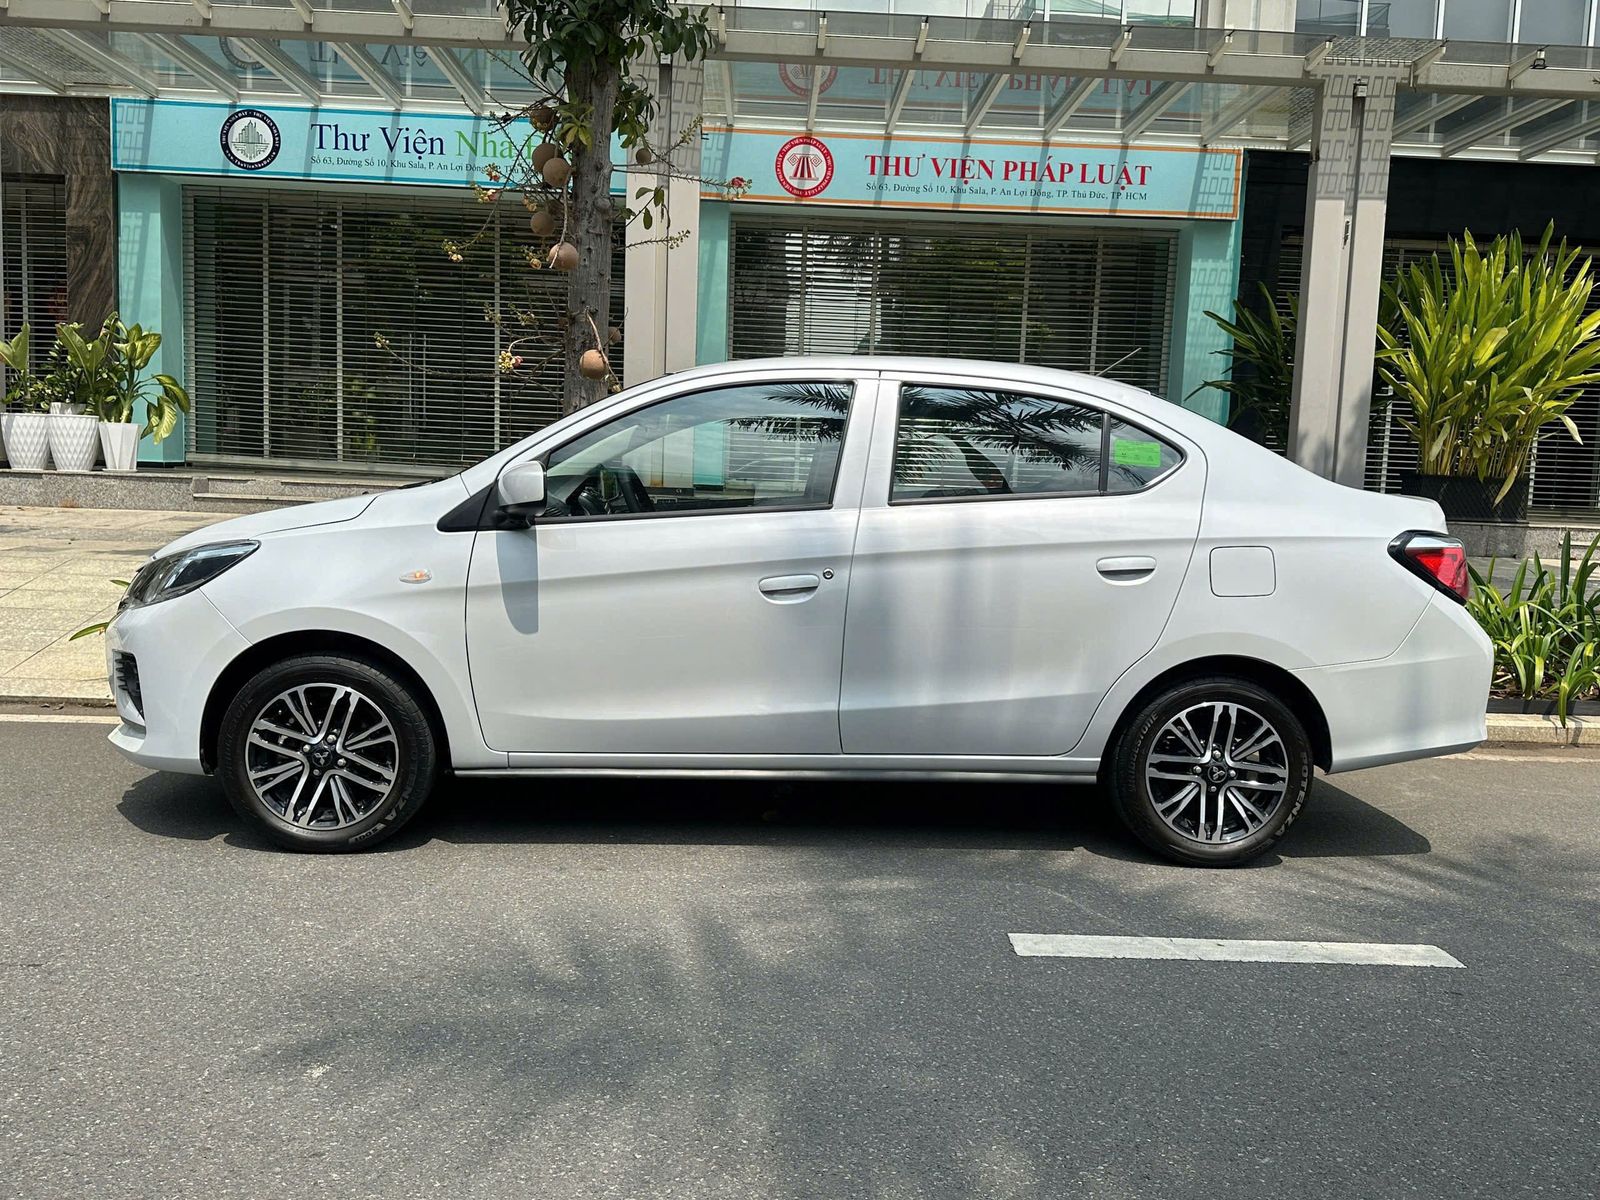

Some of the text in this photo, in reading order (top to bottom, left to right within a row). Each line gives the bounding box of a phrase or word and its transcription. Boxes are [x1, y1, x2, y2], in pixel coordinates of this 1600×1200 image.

[310, 123, 370, 152] Thư
[378, 126, 446, 160] Viện
[310, 154, 321, 165] Số
[322, 156, 335, 166] 63,
[364, 156, 375, 167] Số
[377, 159, 389, 168] 10,
[390, 159, 407, 168] Khu
[436, 162, 448, 171] An
[450, 162, 463, 172] Lợi
[864, 153, 1152, 191] THƯ VIỆN PHÁP LUẬT
[866, 181, 876, 190] Số
[878, 183, 891, 192] 63,
[893, 183, 921, 194] Đường
[922, 182, 933, 193] Số
[936, 185, 948, 194] 10,
[950, 185, 966, 194] Khu
[969, 187, 988, 195] Sala,
[1014, 188, 1027, 197] Lợi
[1056, 190, 1069, 198] TP.
[1072, 190, 1087, 199] Thủ
[1089, 190, 1108, 200] Đức,
[1111, 191, 1123, 200] TP.
[1125, 192, 1147, 200] HCM
[1274, 751, 1309, 837] POTENZA
